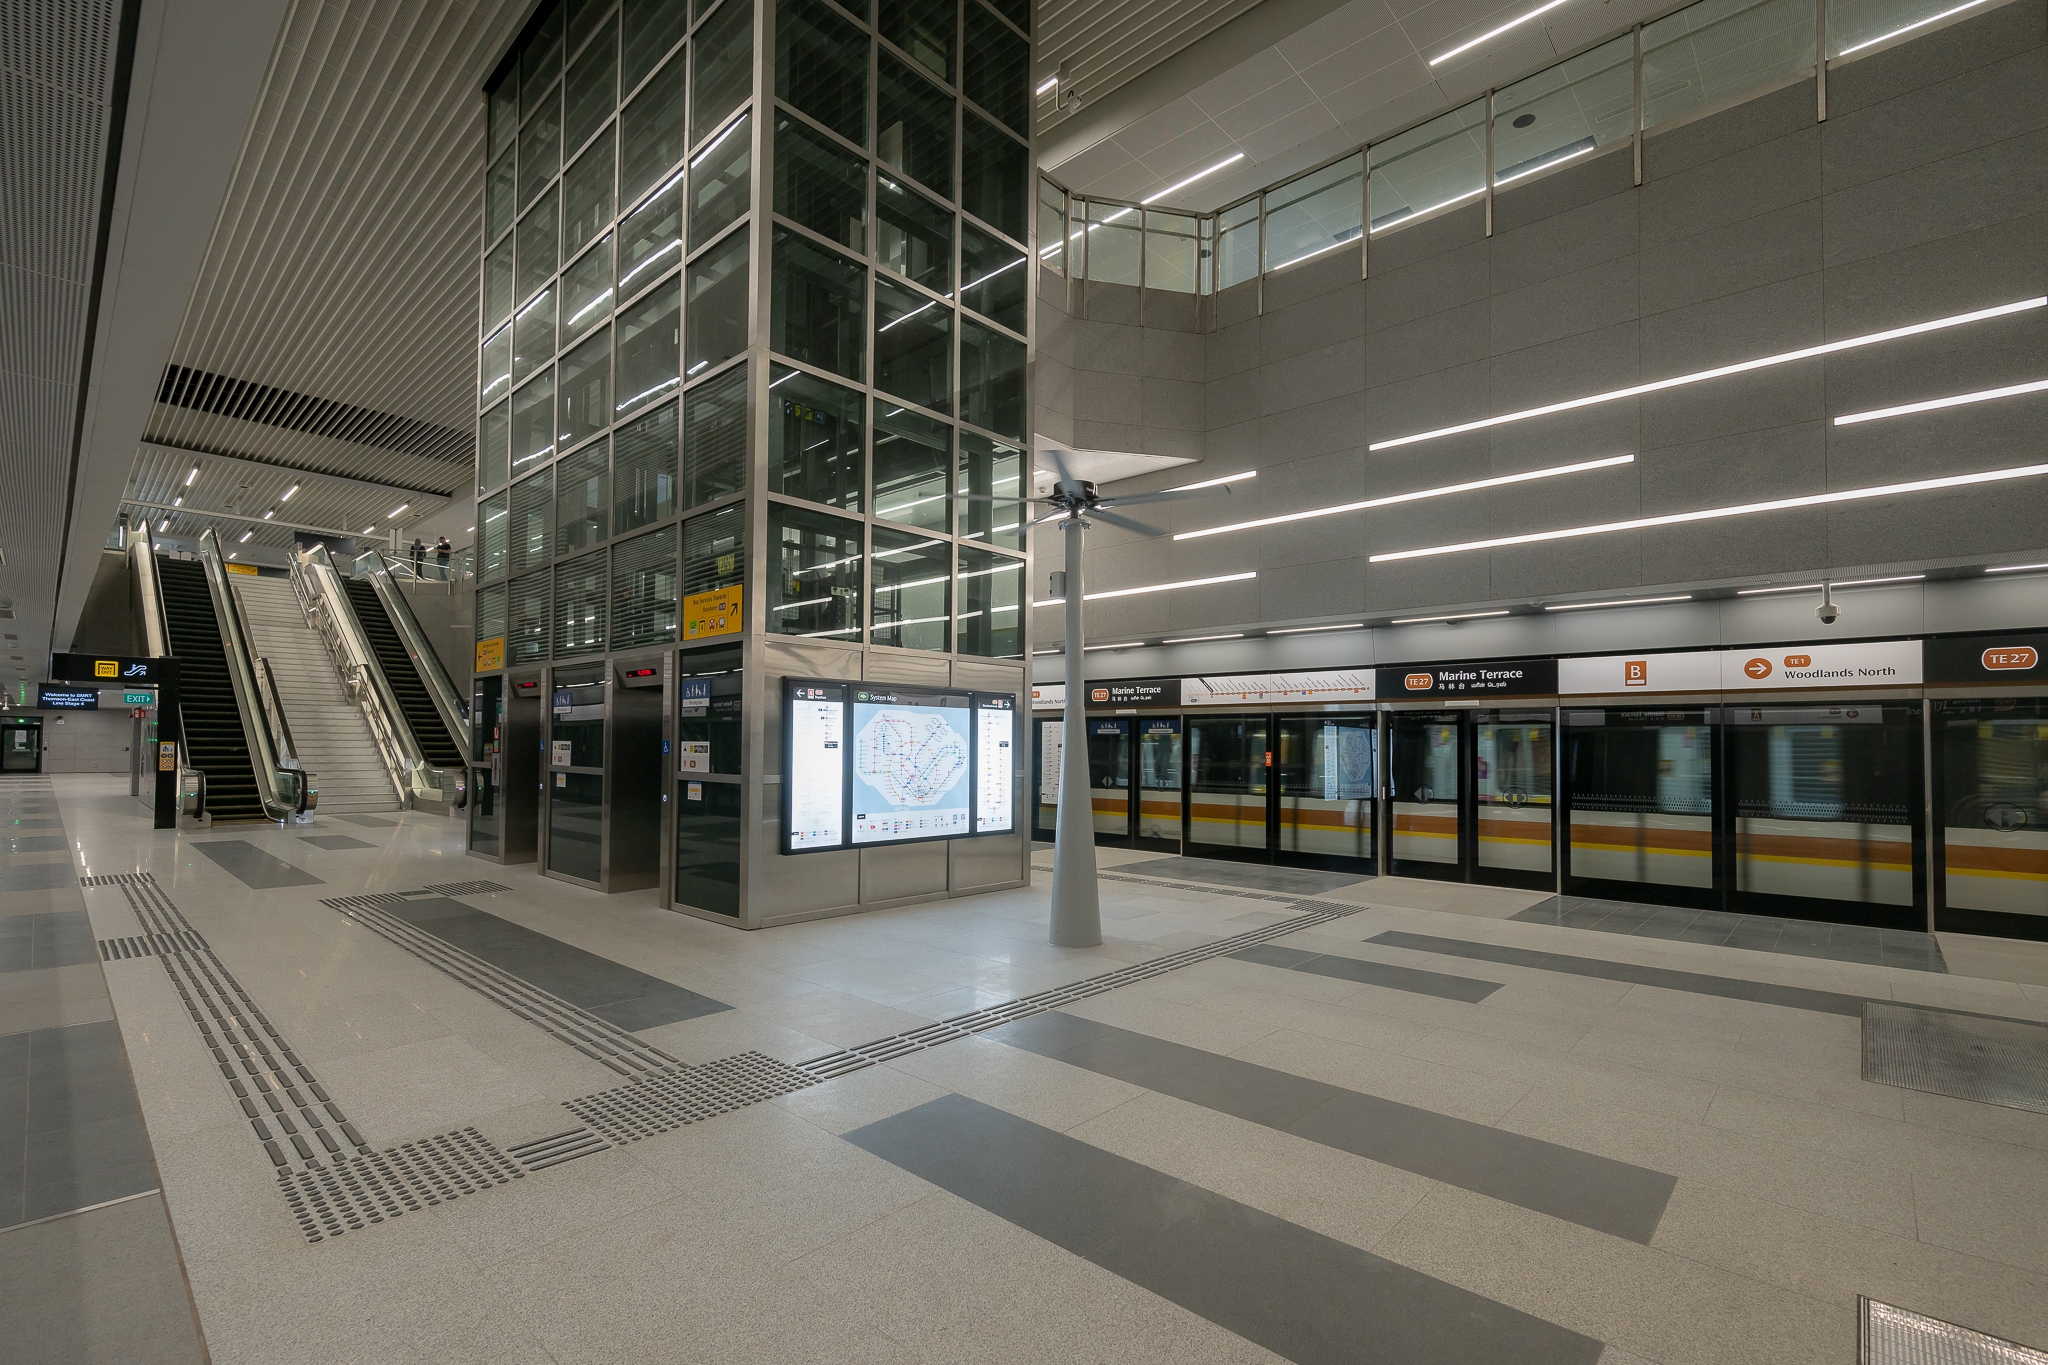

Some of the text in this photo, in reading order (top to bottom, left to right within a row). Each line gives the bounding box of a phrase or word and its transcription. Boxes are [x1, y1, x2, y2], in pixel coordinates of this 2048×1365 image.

[1990, 653, 2029, 663] TE 27
[1439, 670, 1523, 681] Marine Terrace
[1630, 665, 1641, 679] B
[1784, 666, 1896, 679] Woodlands North
[1409, 677, 1429, 686] TE 27
[1112, 686, 1162, 695] Marine Terrace
[126, 695, 145, 703] EXIT
